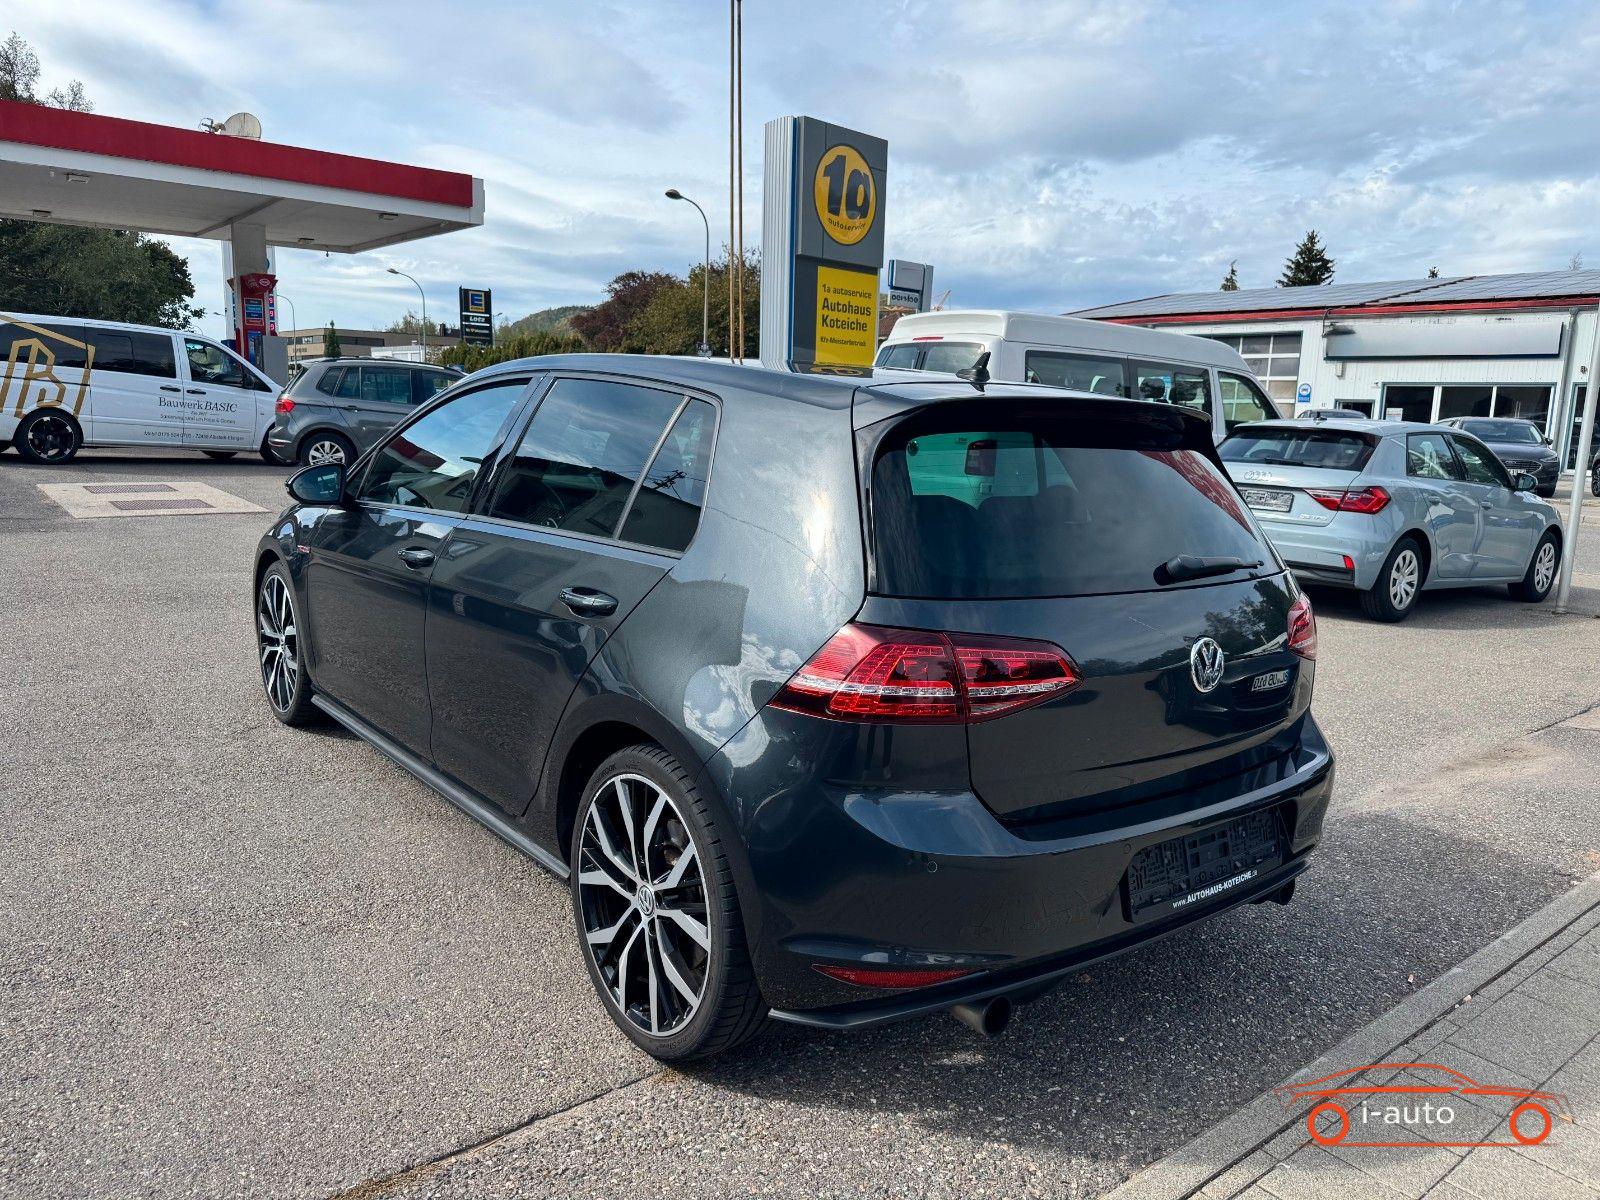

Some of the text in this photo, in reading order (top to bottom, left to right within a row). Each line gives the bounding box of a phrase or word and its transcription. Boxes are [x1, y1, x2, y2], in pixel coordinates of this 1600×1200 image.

[833, 286, 872, 299] autoservice
[822, 297, 872, 316] Autohaus
[821, 314, 868, 332] Koteiche
